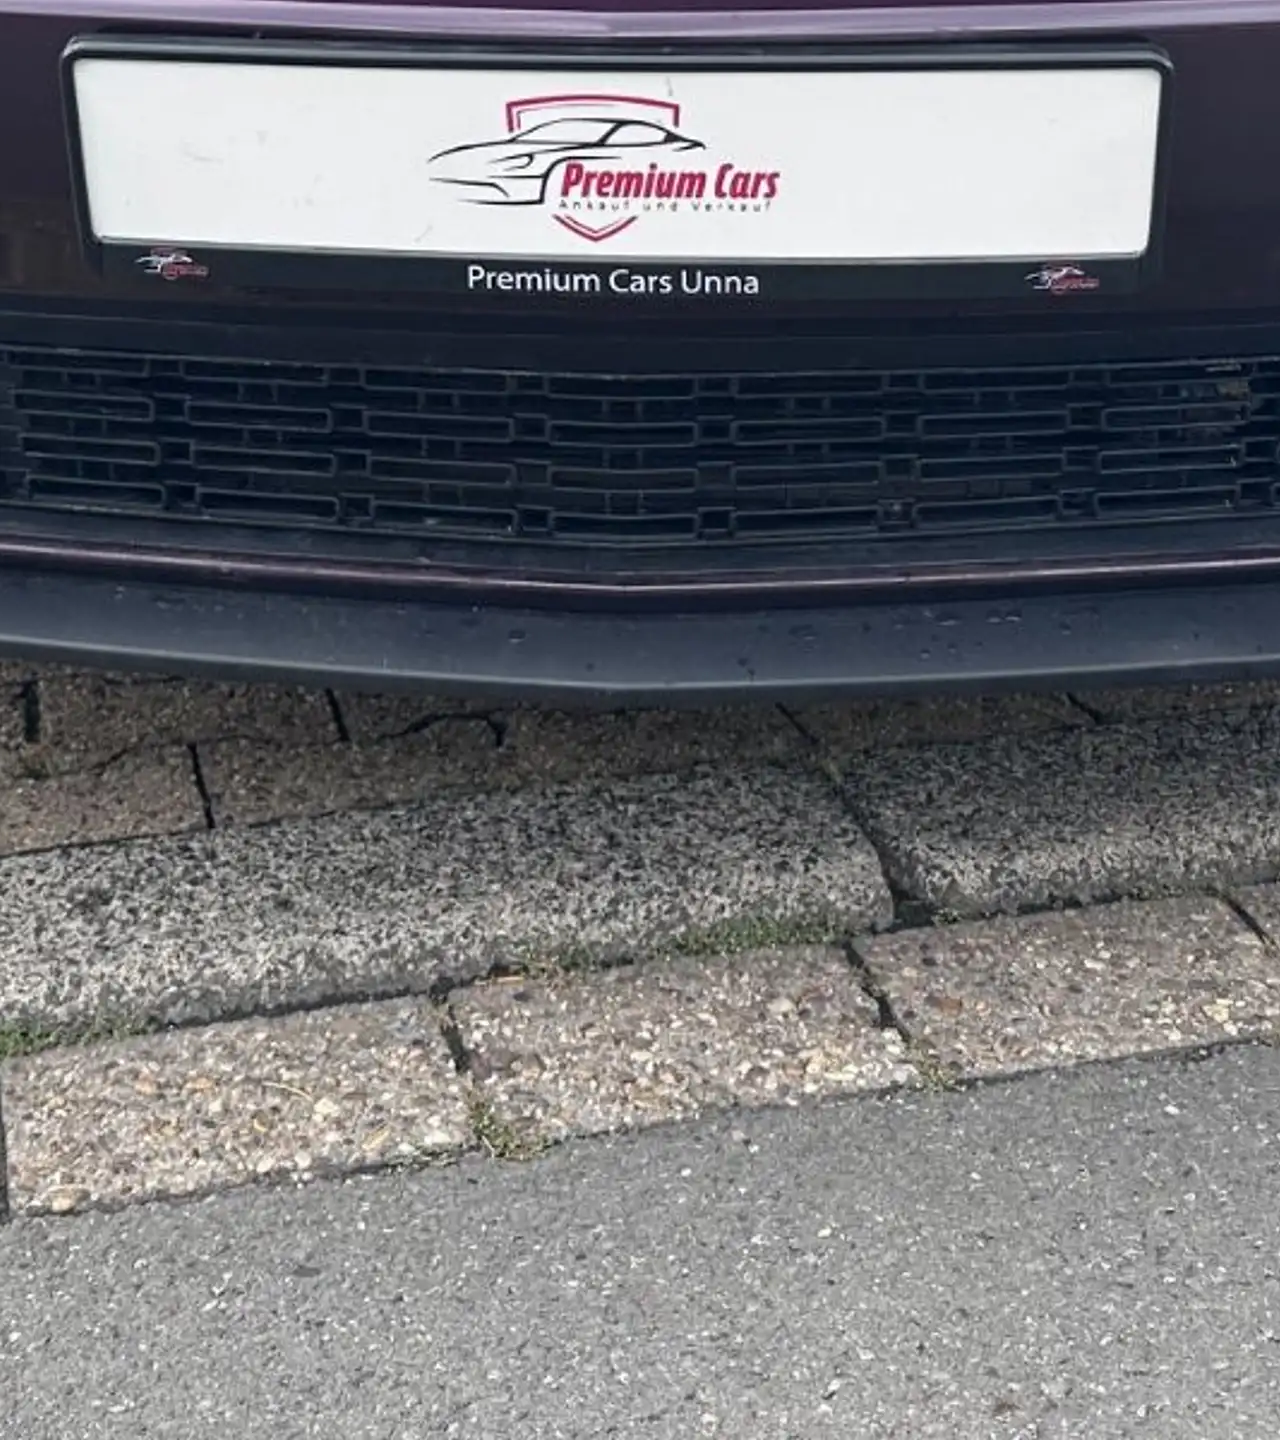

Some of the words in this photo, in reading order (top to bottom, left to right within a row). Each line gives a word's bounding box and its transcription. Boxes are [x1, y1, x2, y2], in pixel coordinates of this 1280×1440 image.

[560, 162, 707, 199] Premium
[714, 162, 781, 199] Cars
[559, 200, 630, 211] Ankauf
[642, 202, 679, 212] und
[467, 265, 602, 293] Premium
[609, 268, 673, 294] Cars
[680, 269, 759, 294] Unna
